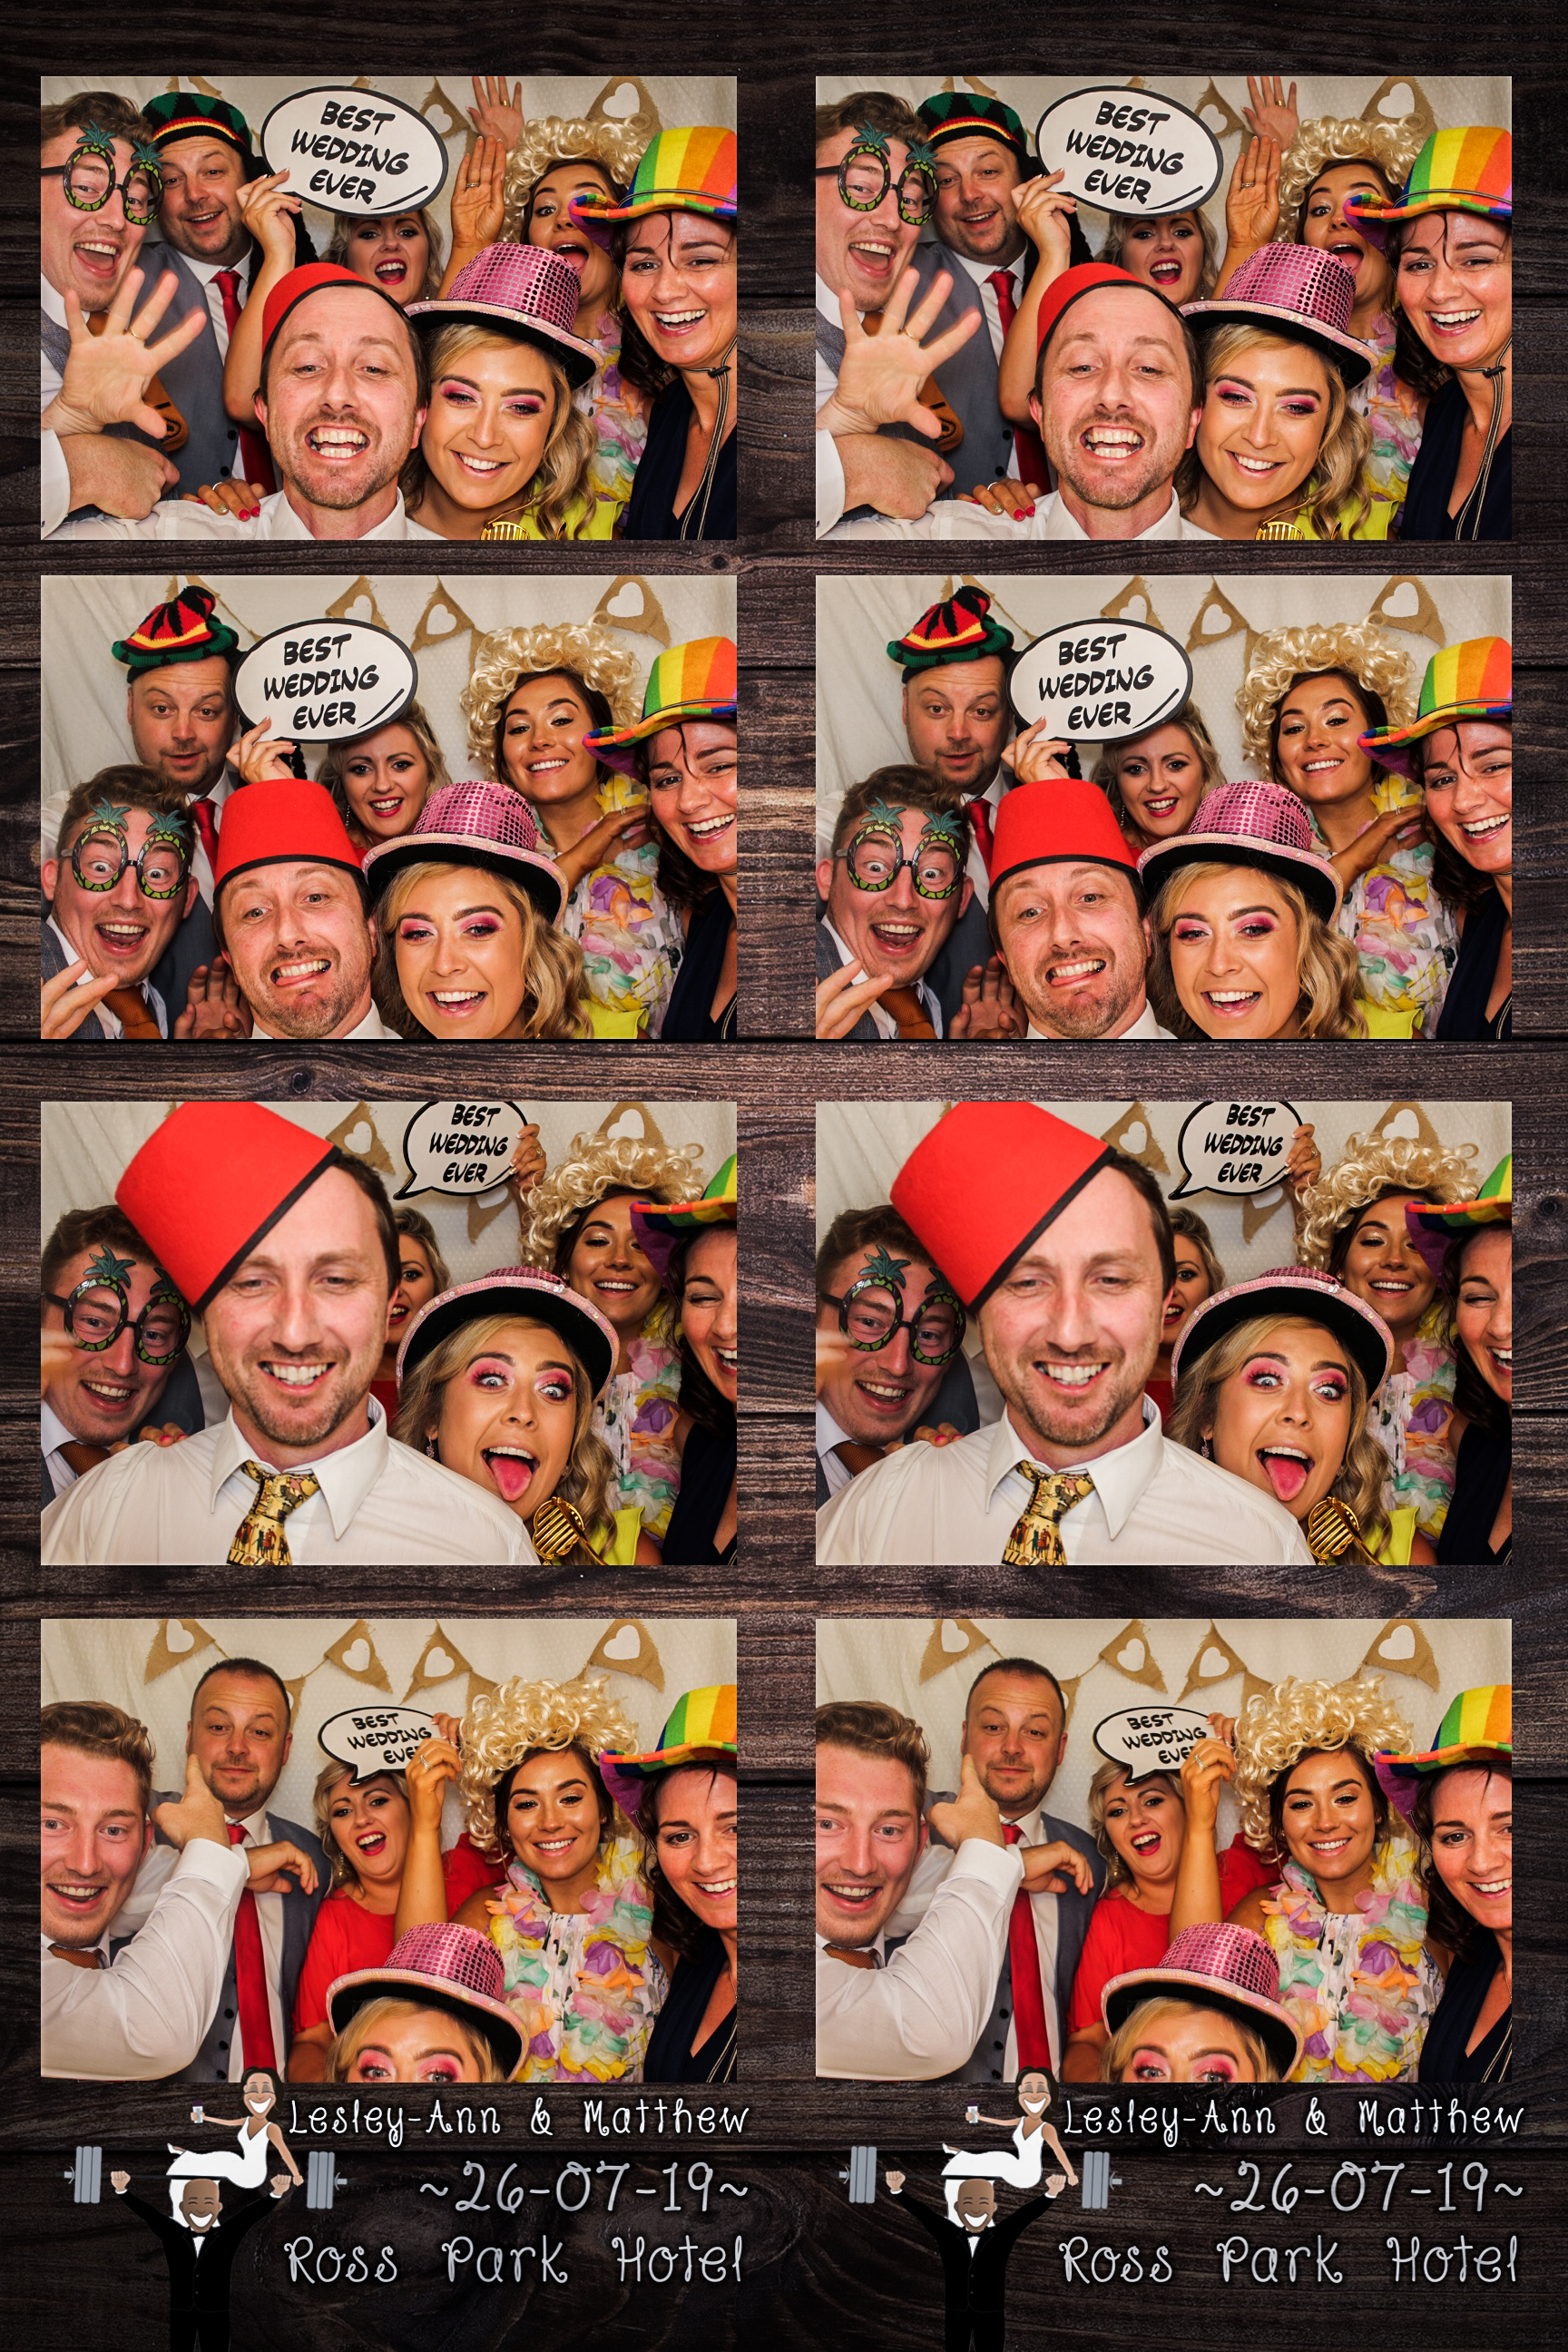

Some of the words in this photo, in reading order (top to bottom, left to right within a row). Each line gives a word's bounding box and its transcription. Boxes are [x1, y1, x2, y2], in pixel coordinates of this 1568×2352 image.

[320, 101, 396, 135] BEST
[1095, 101, 1171, 135] BEST
[291, 129, 409, 175] WEDDING
[1066, 129, 1184, 175] WEDDING
[309, 169, 377, 204] EVER
[1084, 169, 1152, 204] EVER
[284, 633, 352, 665] BEST
[1059, 633, 1127, 665] BEST
[264, 664, 379, 701] WEDDING
[1039, 664, 1154, 701] WEDDING
[293, 701, 357, 730] EVER
[1068, 701, 1132, 730] EVER
[451, 1103, 501, 1127] BEST
[1226, 1103, 1276, 1127] BEST
[429, 1132, 508, 1156] WEDDING
[1204, 1132, 1283, 1156] WEDDING
[443, 1162, 488, 1183] EVER
[1218, 1162, 1263, 1183] EVER
[351, 1713, 399, 1730] BEST
[1126, 1713, 1174, 1730] BEST
[347, 1727, 432, 1749] WEDDING
[1122, 1727, 1207, 1749] WEDDING
[383, 1746, 420, 1764] EVE
[1158, 1746, 1195, 1764] EVE
